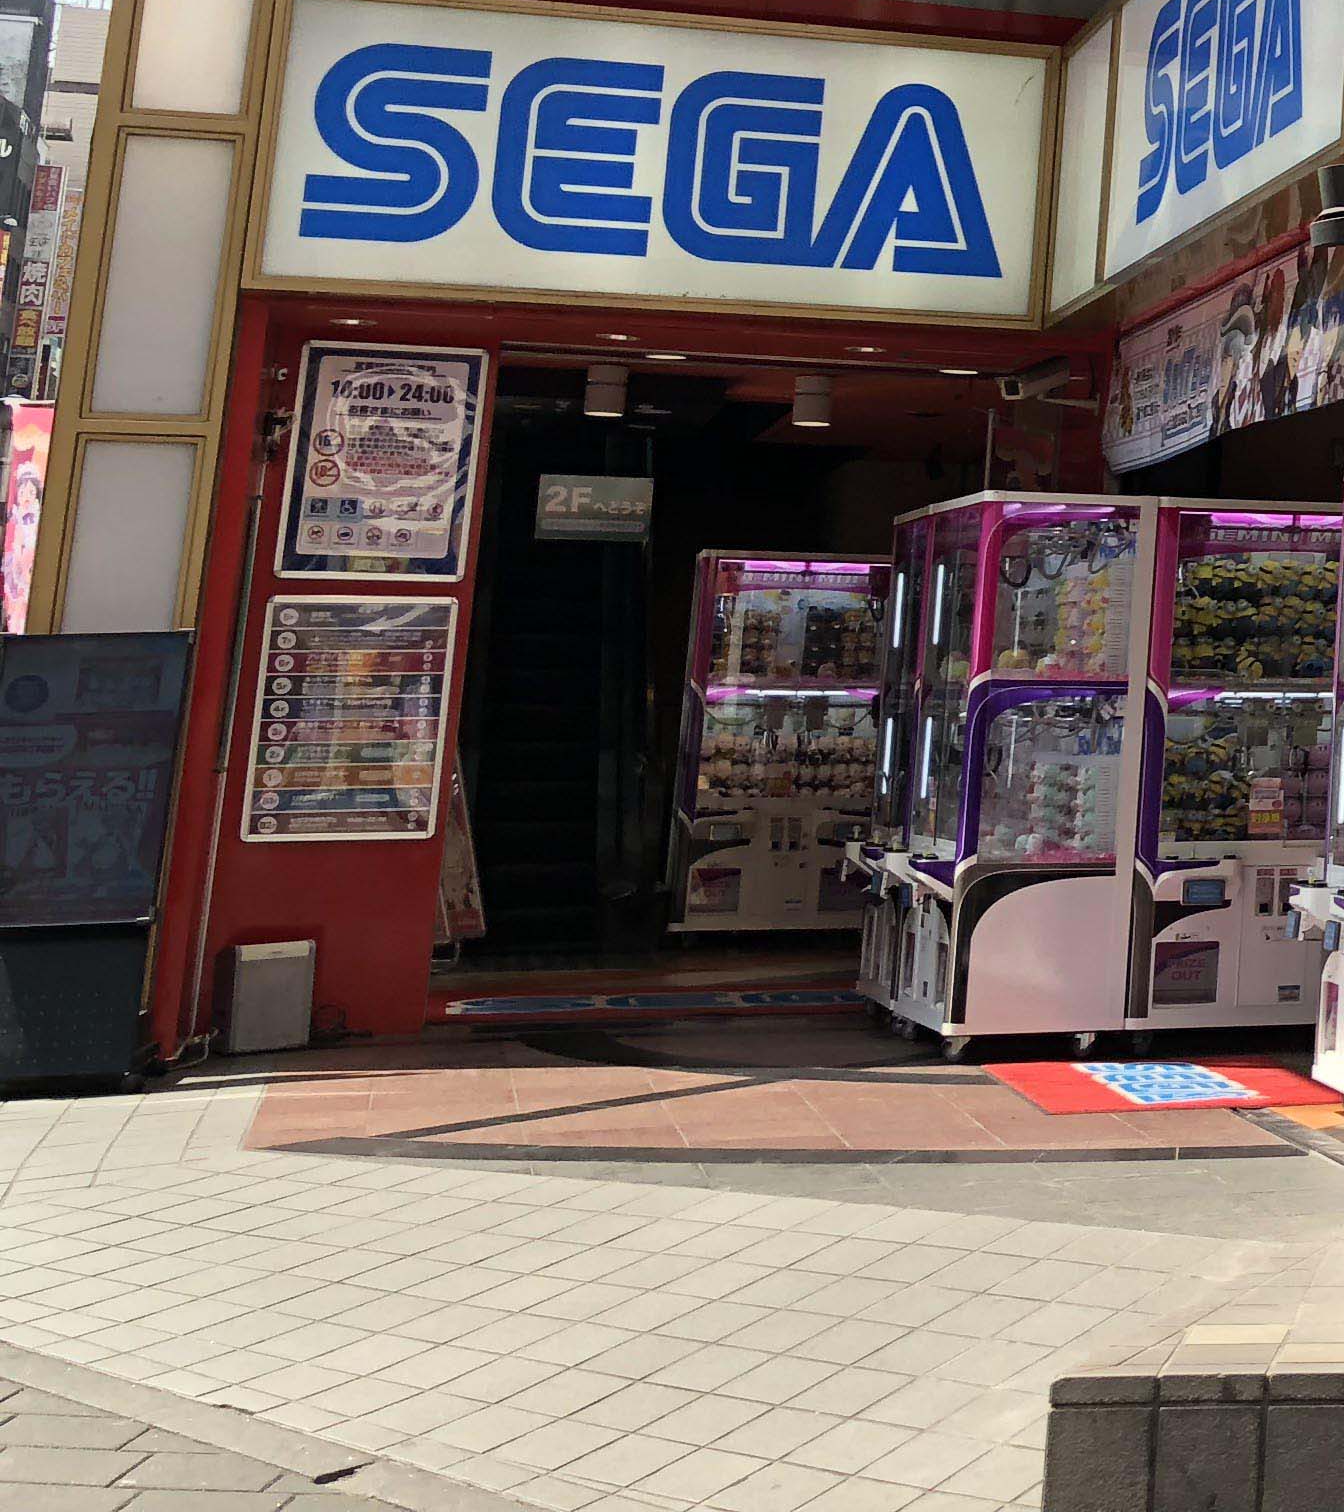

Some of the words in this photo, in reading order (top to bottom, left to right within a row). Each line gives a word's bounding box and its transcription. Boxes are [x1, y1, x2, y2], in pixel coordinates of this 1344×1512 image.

[298, 42, 1003, 280] SEGA
[19, 262, 47, 306] 焼肉
[1171, 970, 1202, 981] OUT
